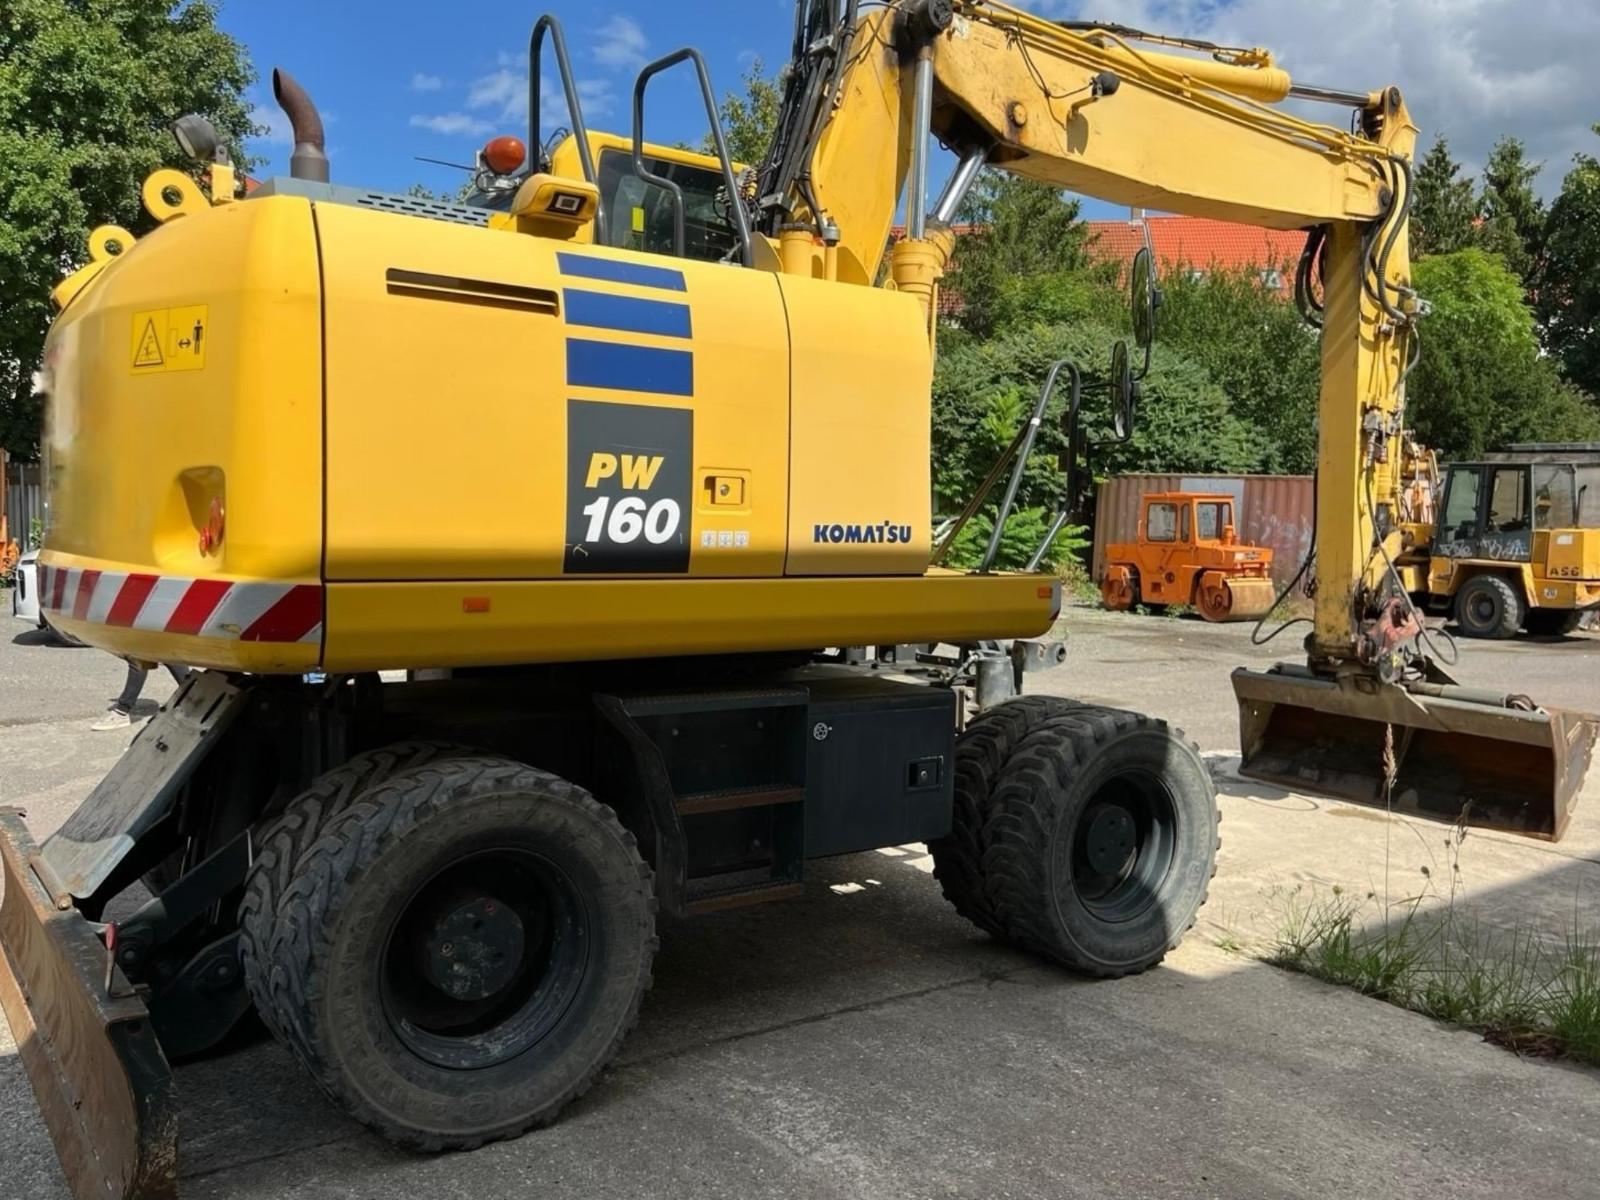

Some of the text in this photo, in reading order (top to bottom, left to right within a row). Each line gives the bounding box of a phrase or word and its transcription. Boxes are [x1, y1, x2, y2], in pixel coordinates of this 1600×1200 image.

[585, 453, 665, 490] PW
[583, 497, 681, 544] 160
[814, 520, 912, 543] KOMATSU
